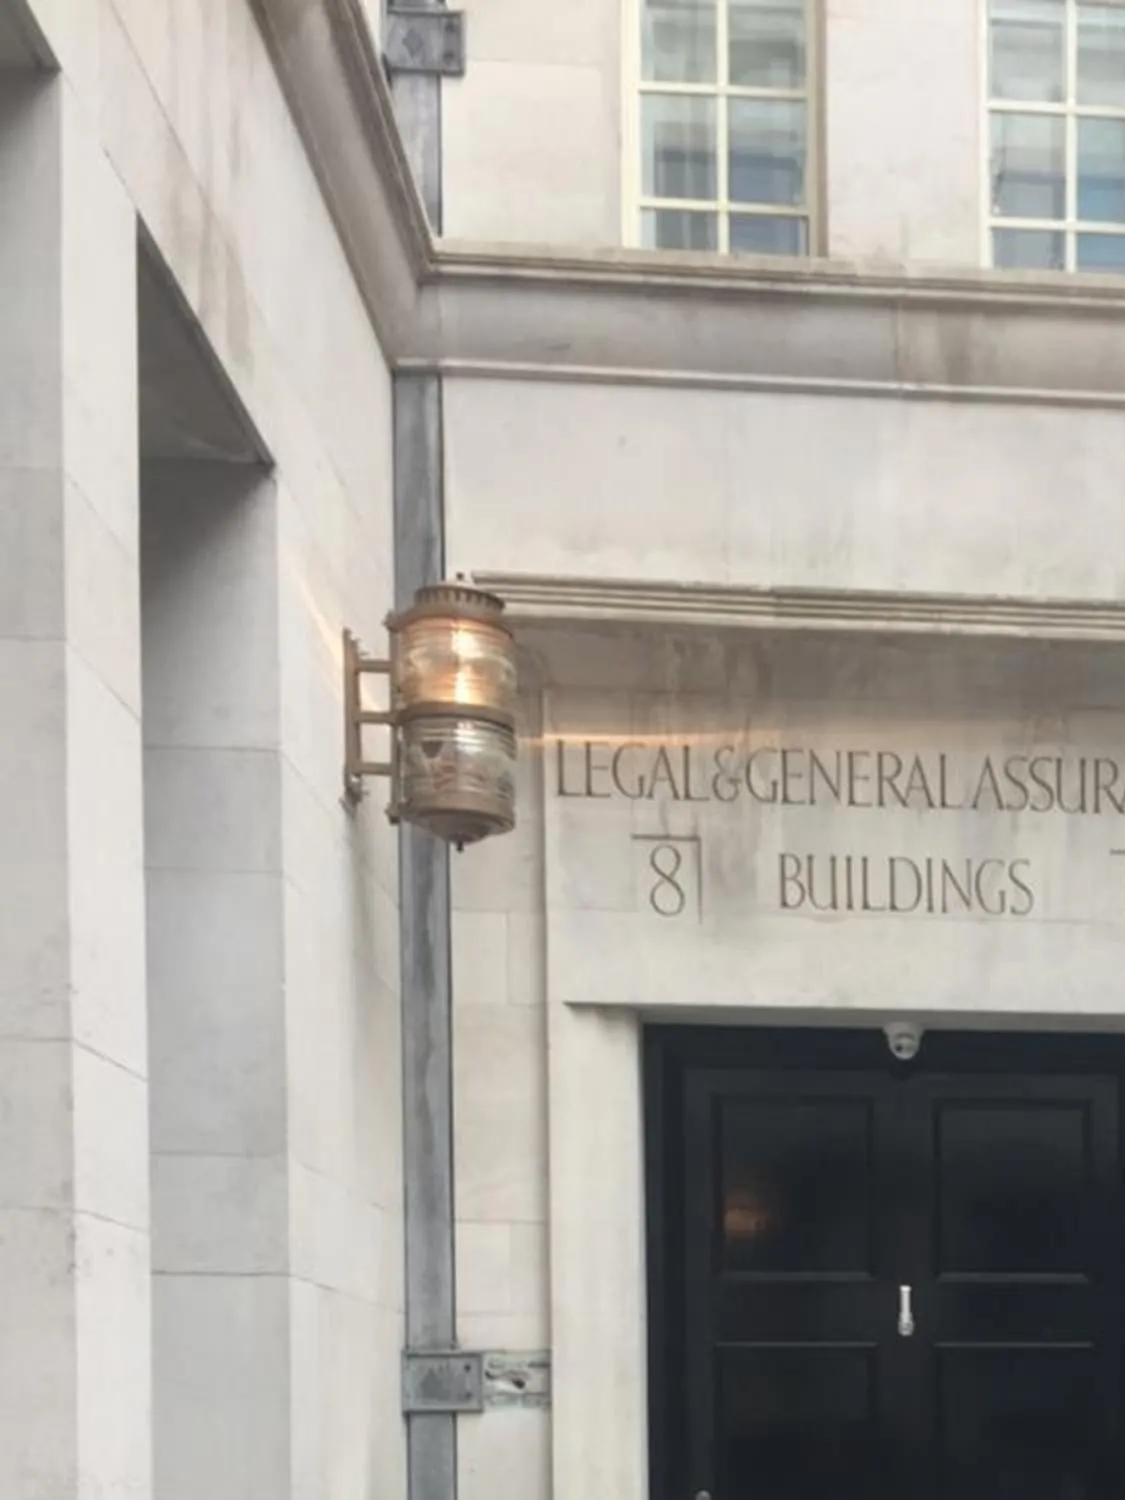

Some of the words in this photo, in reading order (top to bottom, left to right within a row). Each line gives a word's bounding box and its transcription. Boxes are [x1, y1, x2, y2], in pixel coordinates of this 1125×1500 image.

[555, 739, 710, 801] LEGAL
[745, 747, 964, 809] GENERAL
[649, 843, 686, 917] 8
[778, 852, 1035, 916] BUILDINGS
